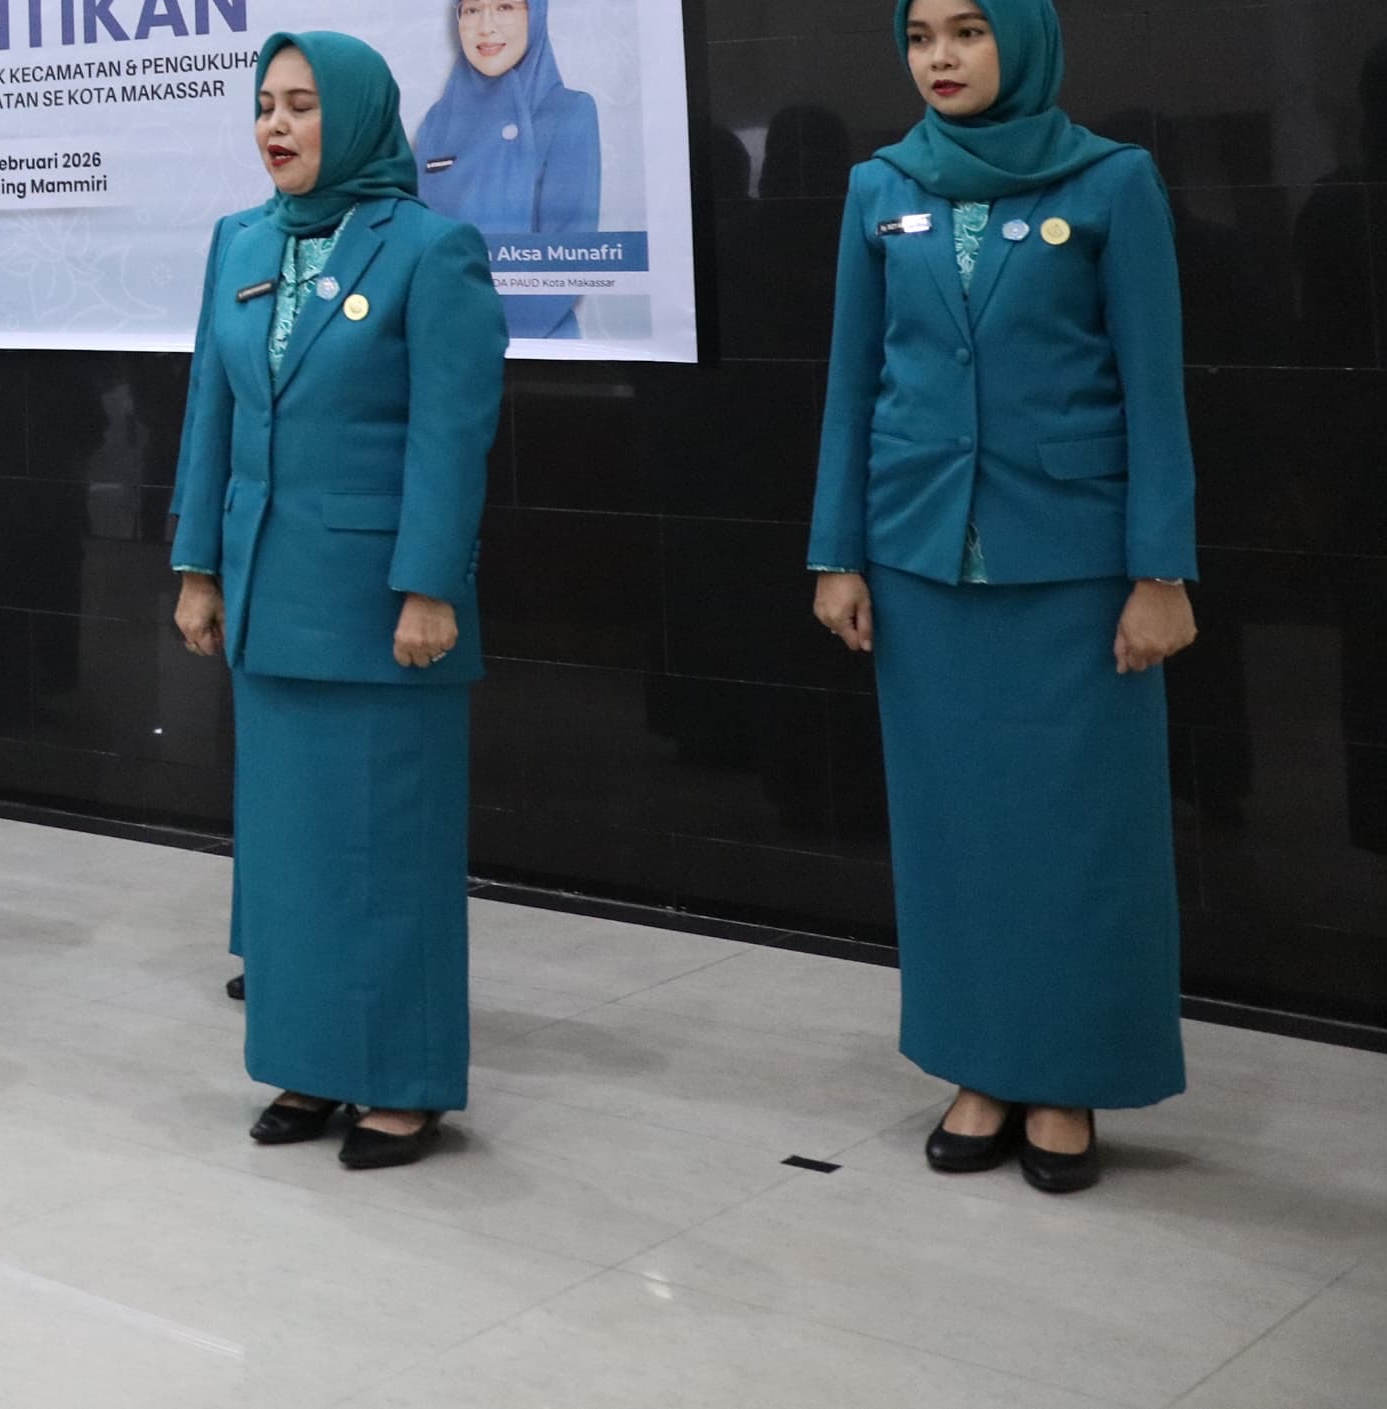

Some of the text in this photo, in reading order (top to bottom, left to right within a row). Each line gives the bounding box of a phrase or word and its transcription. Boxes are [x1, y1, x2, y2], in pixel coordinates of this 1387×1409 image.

[10, 61, 121, 83] KECAMATAN
[125, 59, 138, 76] &
[43, 90, 64, 107] SE
[68, 87, 117, 105] KOTA
[121, 80, 225, 103] MAKASSAR
[62, 151, 101, 169] 2026
[31, 175, 107, 194] Mammiri
[497, 243, 623, 261] Aksa Munafri
[510, 278, 540, 288] PAUD
[542, 278, 565, 288] Kota
[567, 278, 615, 288] Makassar
